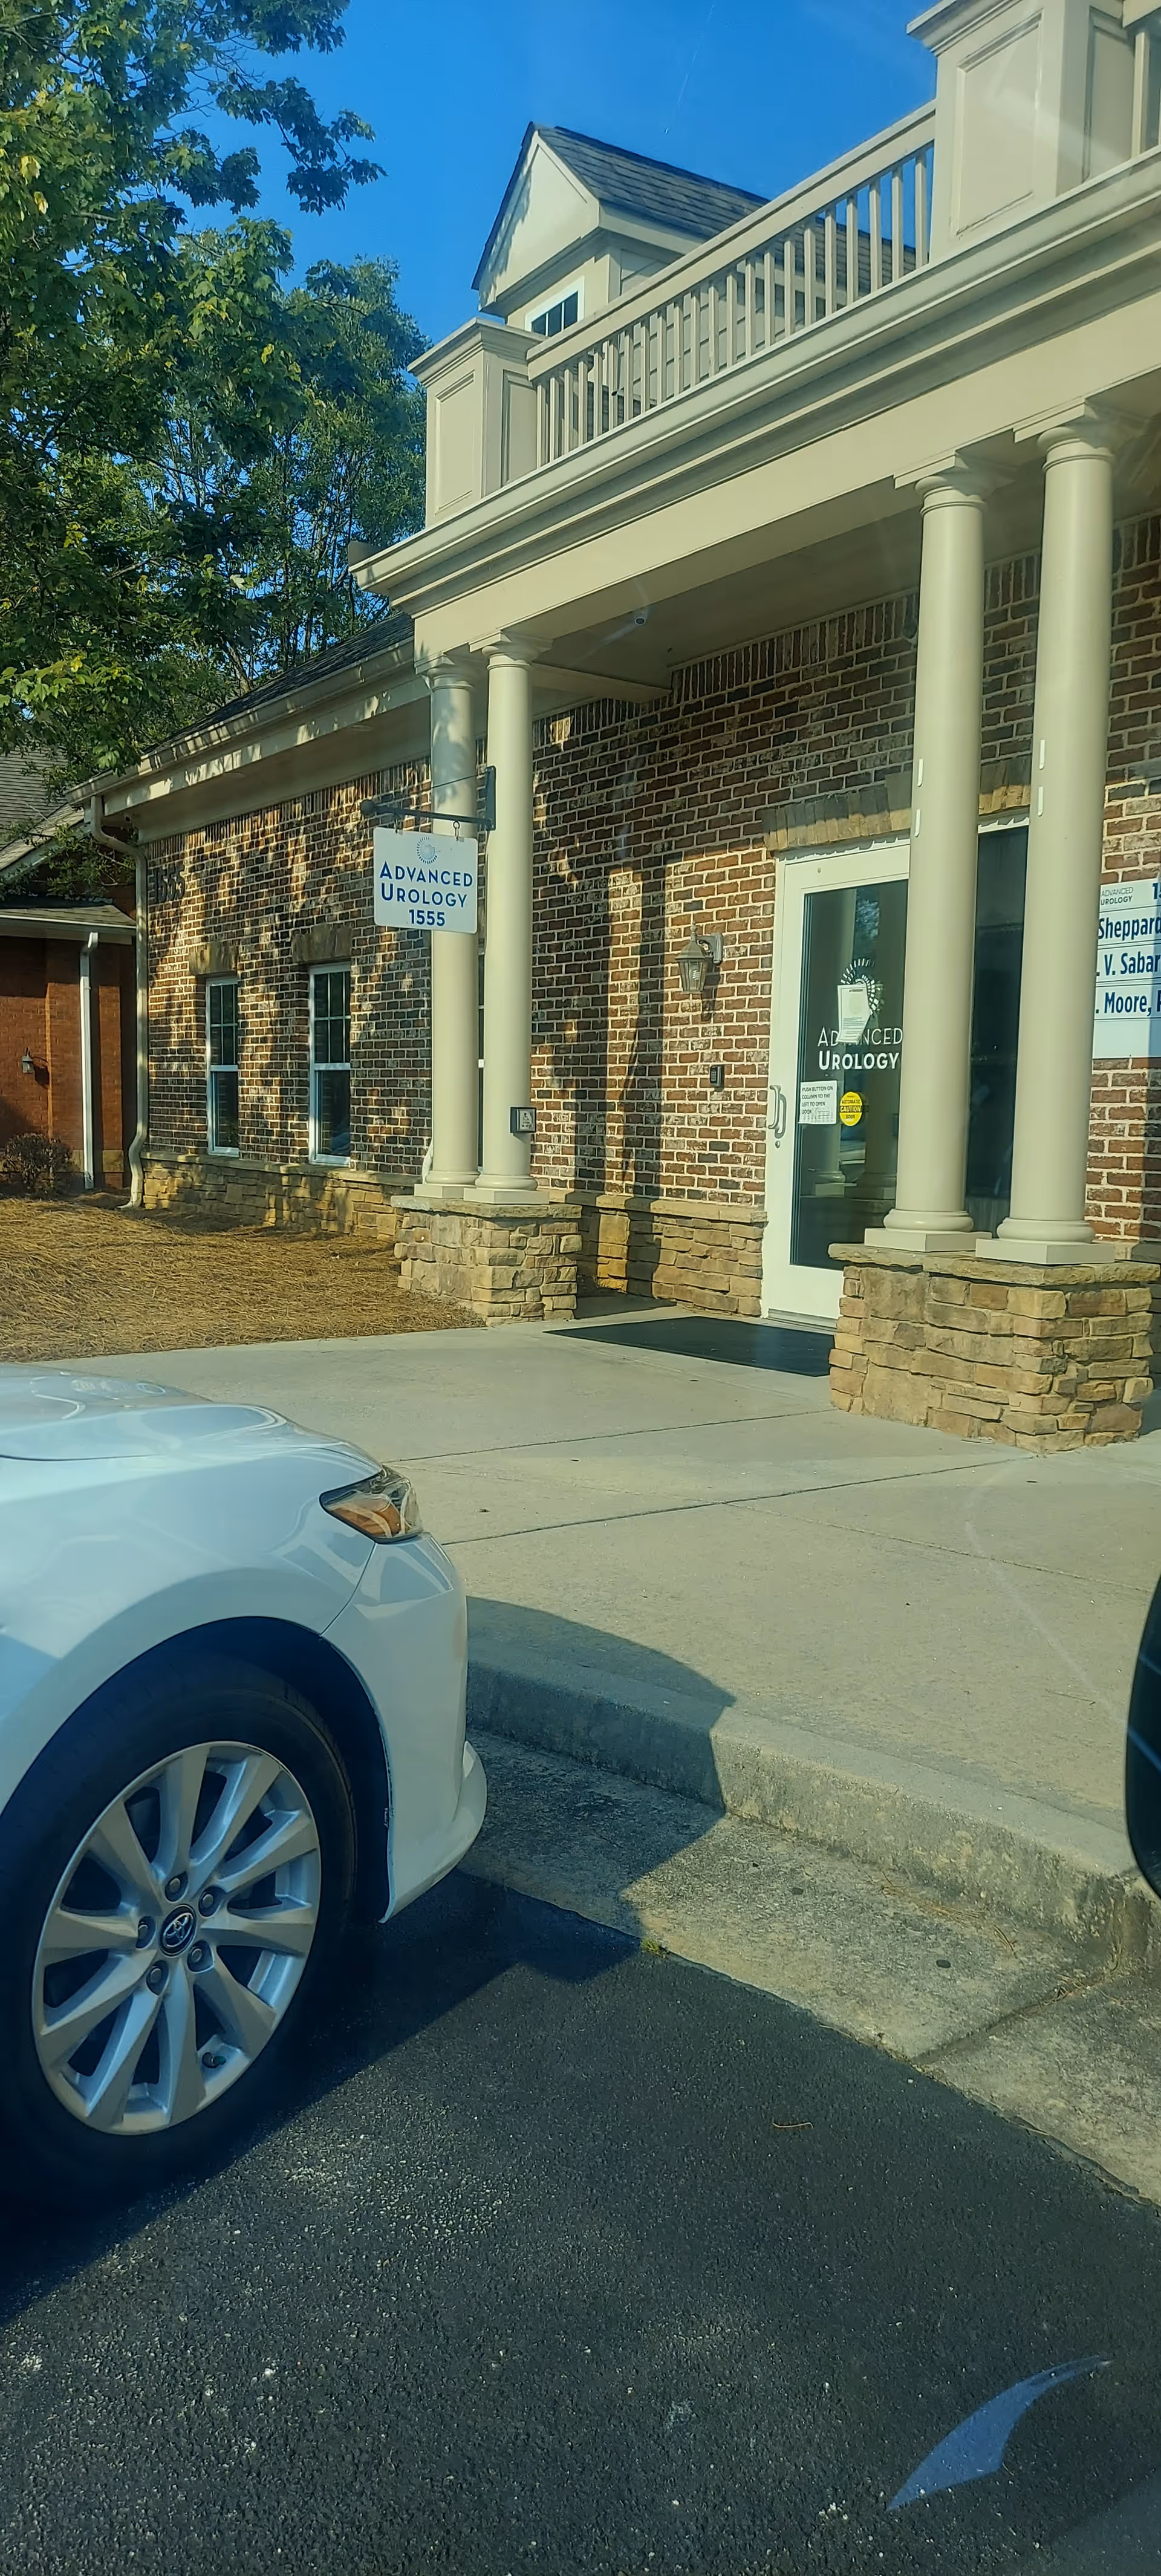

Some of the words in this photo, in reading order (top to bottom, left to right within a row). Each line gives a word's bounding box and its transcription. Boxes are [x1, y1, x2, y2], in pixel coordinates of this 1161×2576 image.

[379, 861, 473, 887] ADVANCED
[381, 882, 468, 908] UROLOGY
[1101, 886, 1134, 897] ADVANCED
[1101, 896, 1133, 905] UROLOGY
[409, 909, 445, 926] 1555
[1104, 954, 1116, 976] V.
[1104, 992, 1152, 1016] Moore,
[818, 1026, 903, 1047] ADNCED
[819, 1050, 899, 1070] UROLOGY
